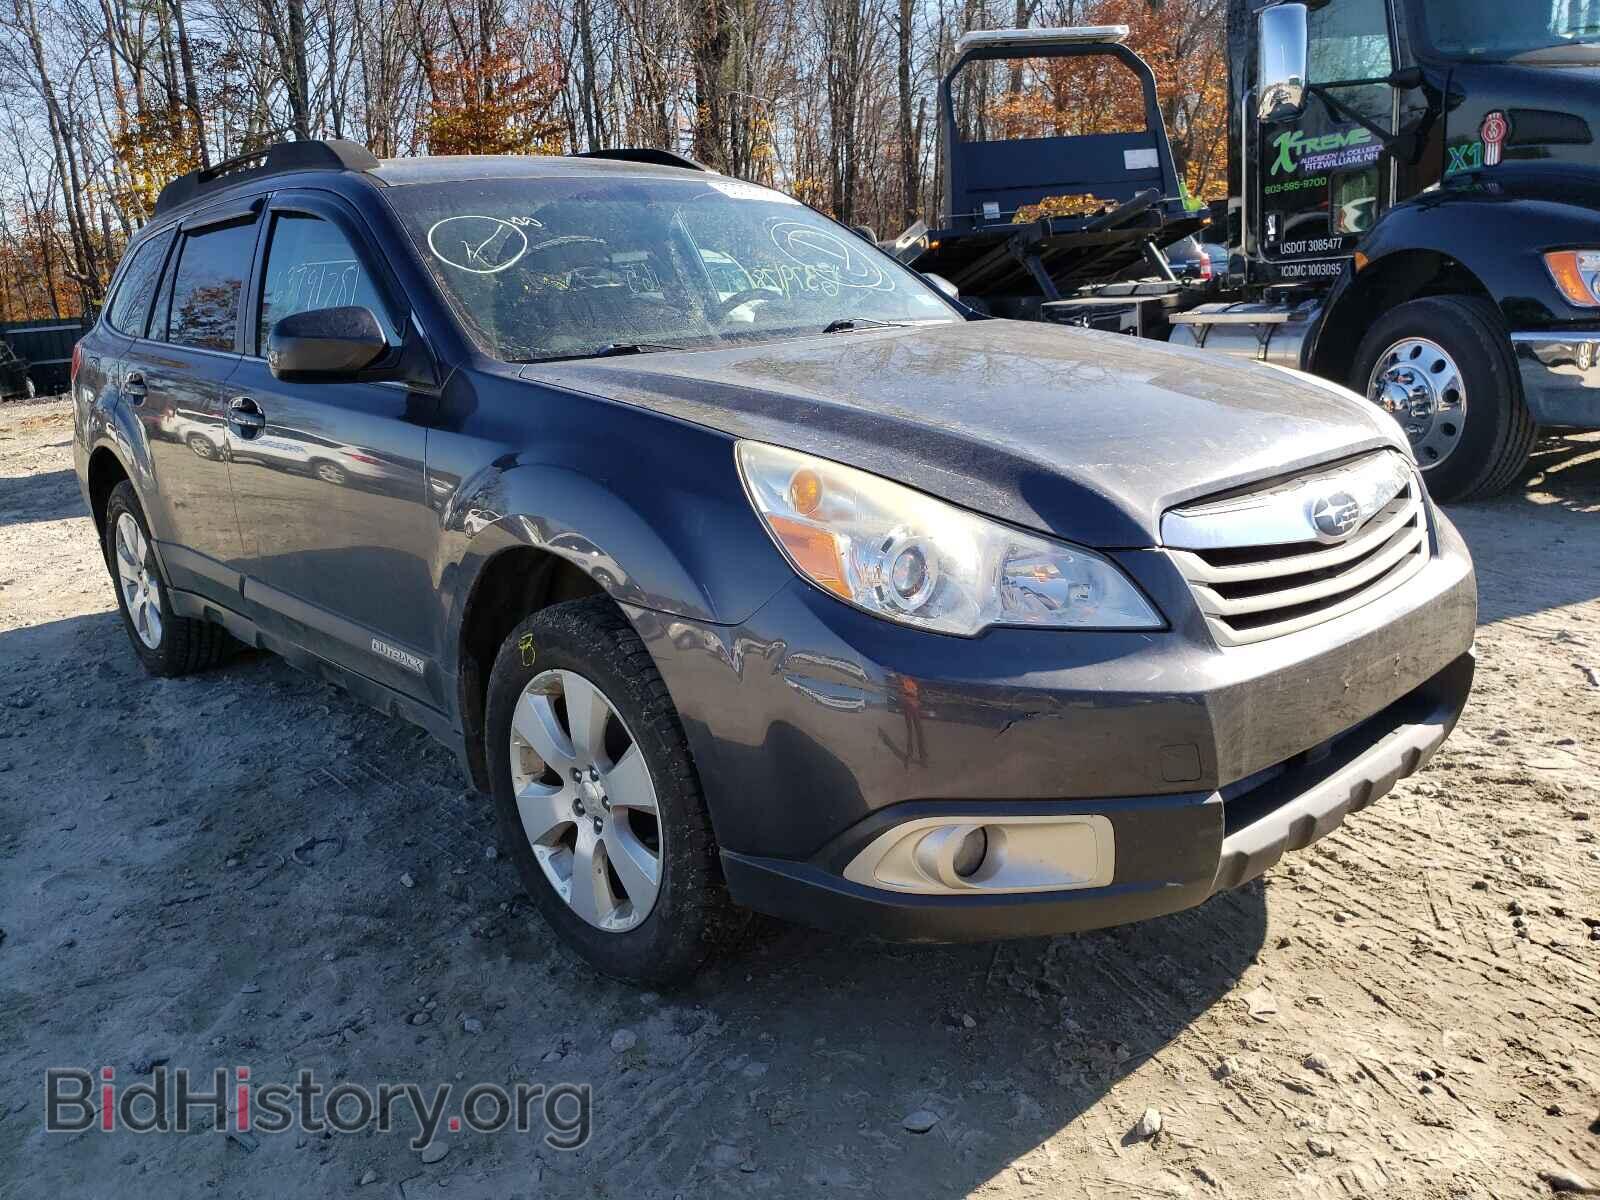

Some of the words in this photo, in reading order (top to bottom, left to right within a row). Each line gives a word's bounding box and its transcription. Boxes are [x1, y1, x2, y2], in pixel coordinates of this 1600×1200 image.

[1363, 151, 1379, 162] NH
[1447, 142, 1482, 176] X1
[1280, 240, 1307, 255] USDOT
[1308, 237, 1343, 252] 3085477
[1281, 264, 1307, 277] ICCMC
[1308, 263, 1342, 276] 1003095
